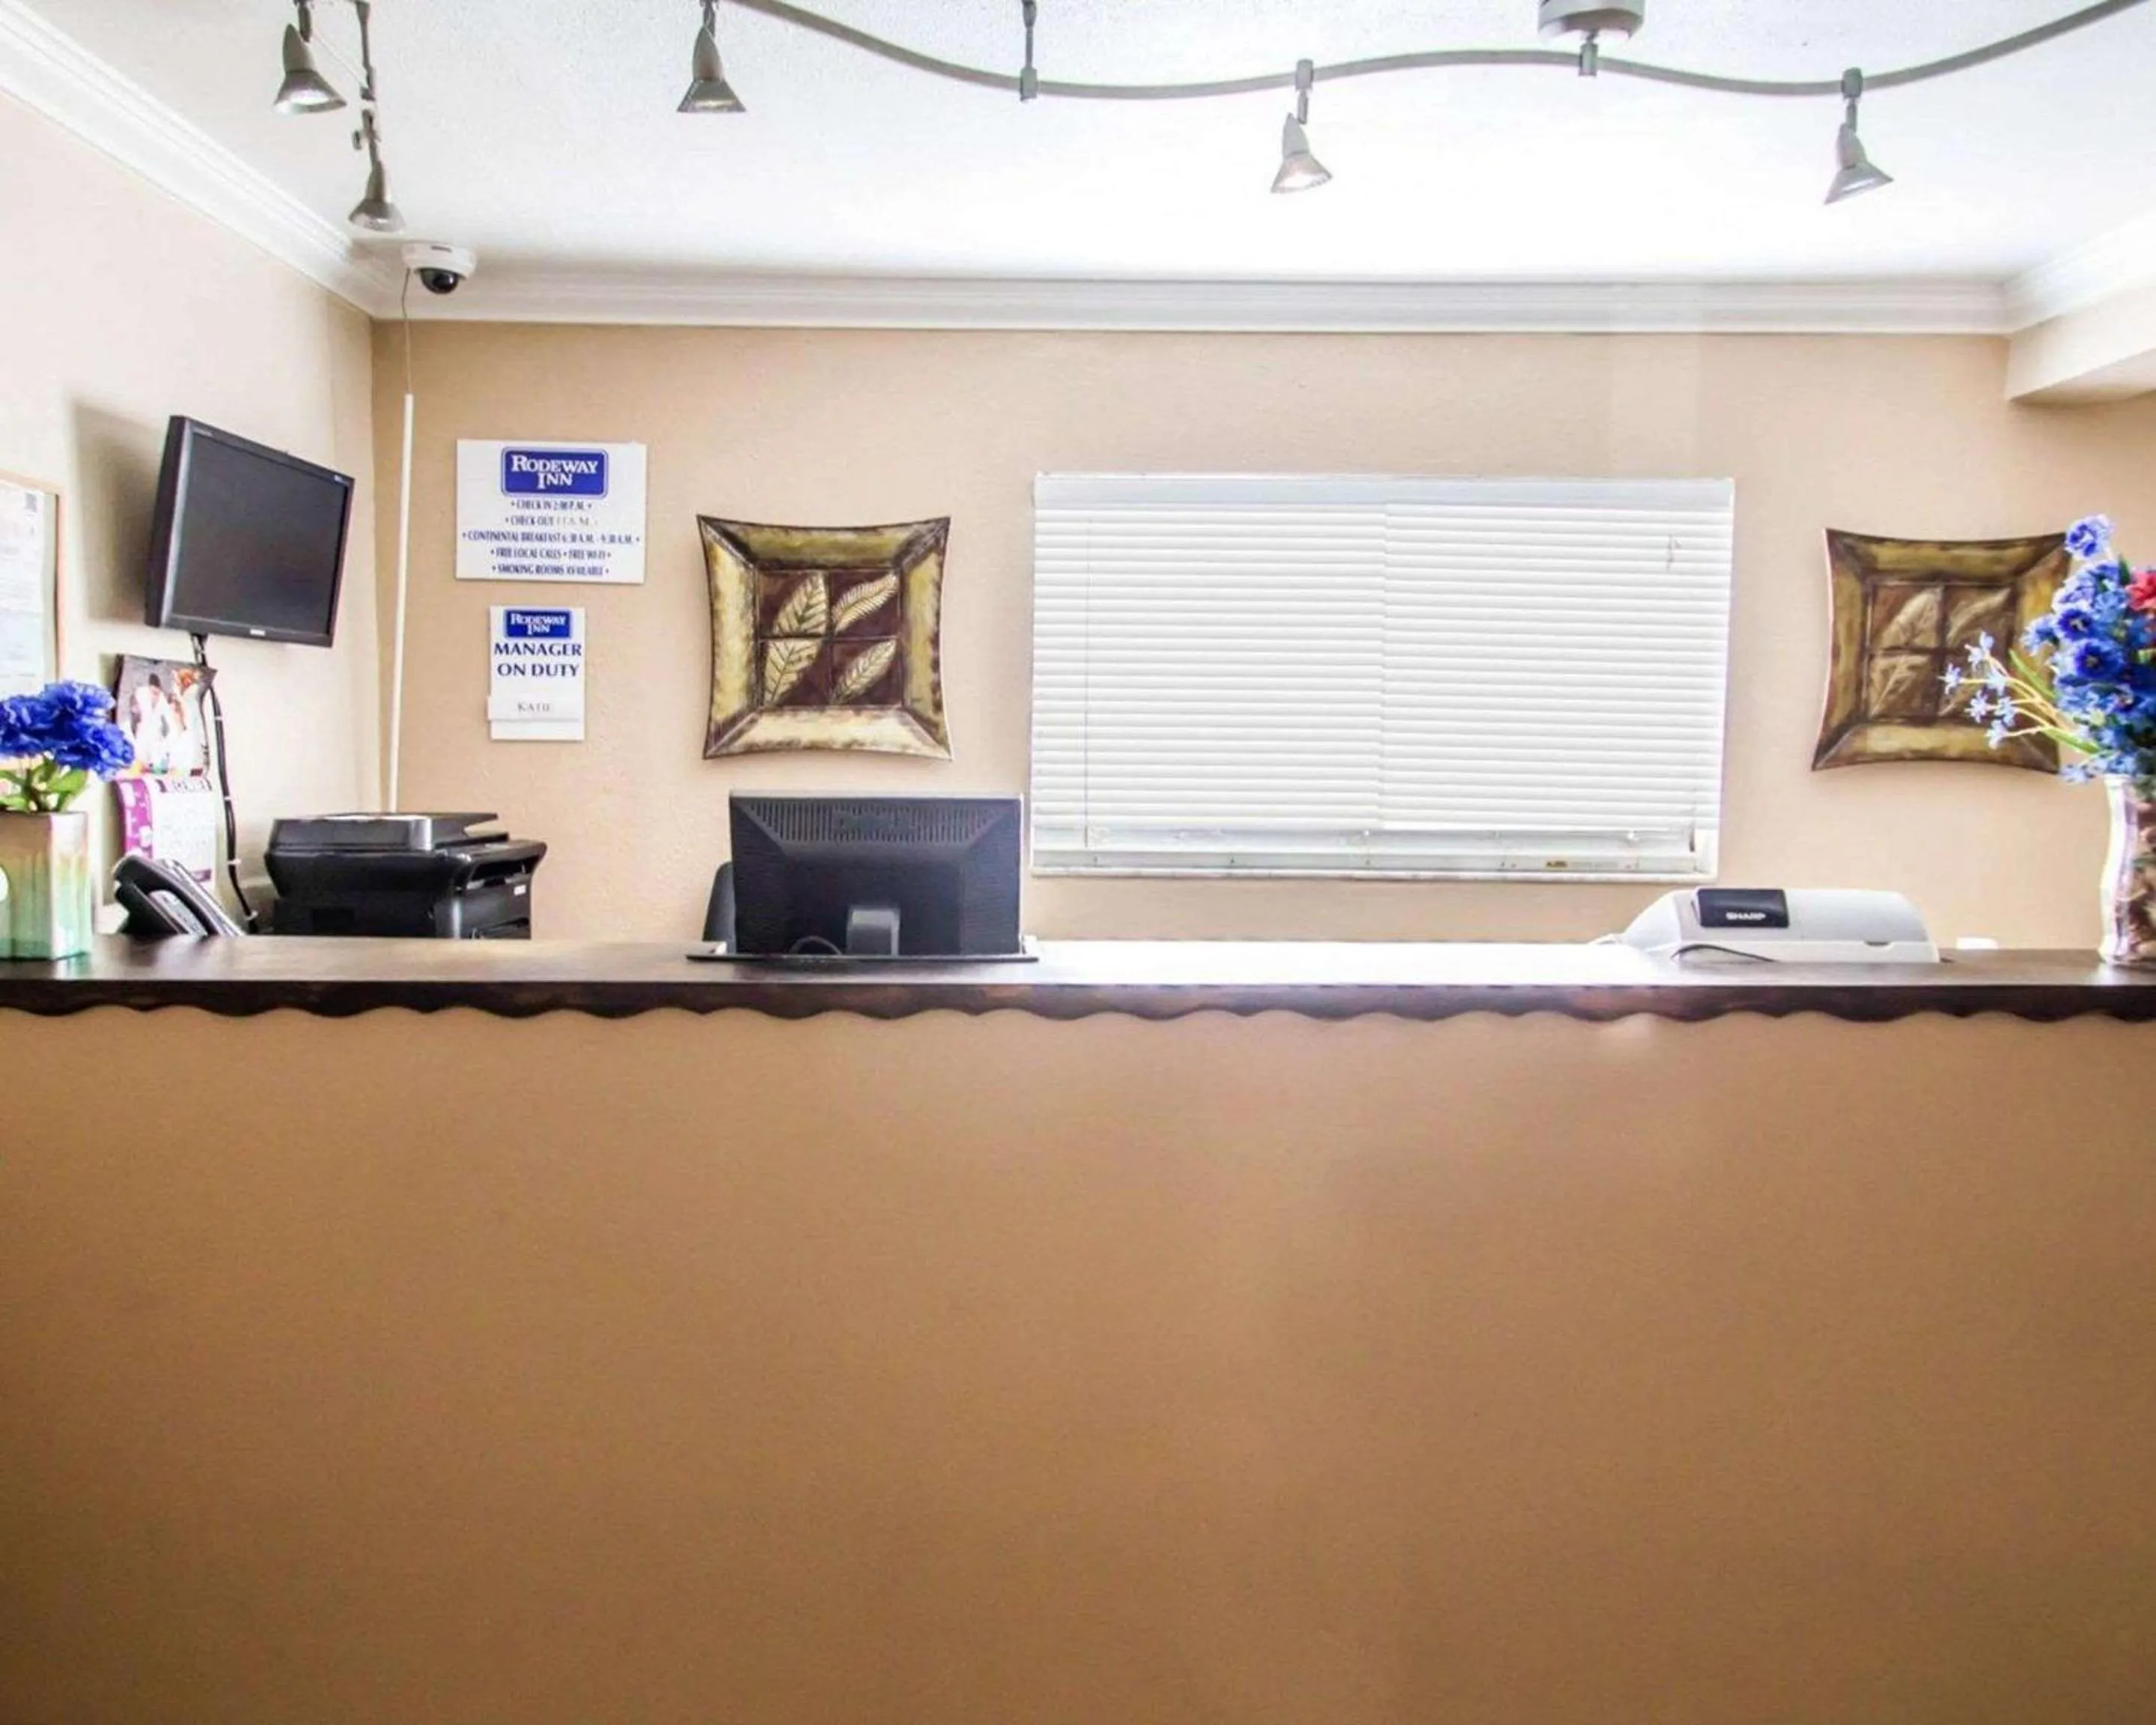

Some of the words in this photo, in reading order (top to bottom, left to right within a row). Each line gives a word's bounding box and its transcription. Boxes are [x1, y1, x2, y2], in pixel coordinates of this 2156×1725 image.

[511, 454, 598, 474] RODEWAY
[538, 472, 573, 489] INN
[516, 499, 541, 510] CHECK
[543, 500, 552, 510] IN
[511, 514, 535, 526] CHECK
[538, 515, 554, 526] OUT
[510, 613, 566, 626] RODEWAY
[526, 624, 550, 635] INN
[494, 642, 582, 656] MANAGER
[497, 663, 526, 677] ON
[531, 663, 579, 677] DUTY
[1726, 912, 1766, 921] SHARP
